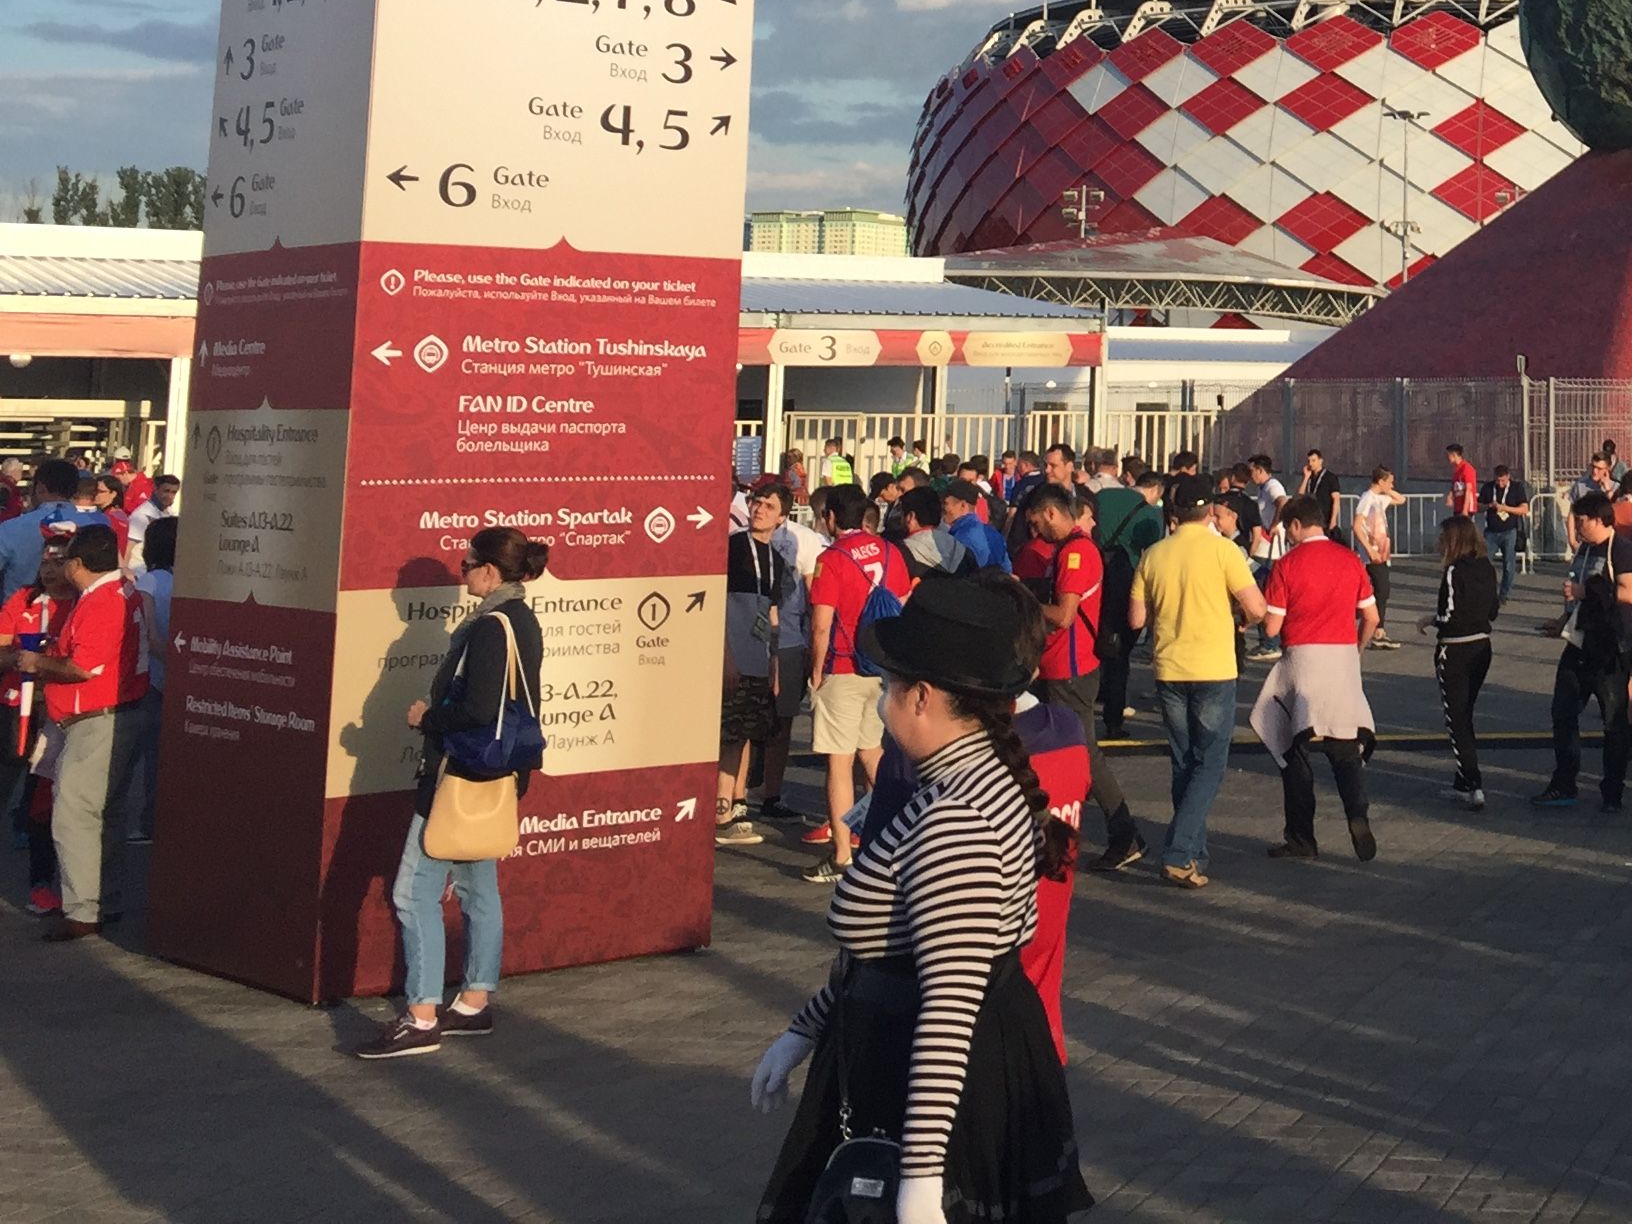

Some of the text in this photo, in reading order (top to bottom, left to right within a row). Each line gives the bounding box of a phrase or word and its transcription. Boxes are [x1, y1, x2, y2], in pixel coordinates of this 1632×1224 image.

[240, 38, 256, 80] 3
[261, 34, 285, 53] Gate
[596, 35, 693, 84] Gate 3
[610, 63, 648, 84] Вход
[280, 97, 304, 117] Gate
[529, 97, 583, 120] Gate
[543, 125, 583, 146] Вход
[229, 176, 246, 218] 6
[251, 173, 275, 192] Gate
[439, 163, 550, 207] 6 Gate
[491, 194, 532, 214] Вход
[414, 269, 696, 293] Please, use the Gate indicated on your ticket
[413, 286, 482, 299] Пожалуйста,
[483, 290, 551, 302] используйте
[580, 292, 632, 304] указанный
[634, 296, 646, 304] на
[648, 294, 681, 306] Вашем
[683, 295, 717, 308] билете
[462, 335, 707, 362] Metro Station Tushinskaya
[779, 341, 811, 355] Gate
[818, 336, 836, 360] 3
[461, 359, 668, 378] Станция метро "Тушинская"
[458, 395, 594, 414] FAN ID Centre
[501, 421, 556, 437] выдачи
[559, 422, 626, 437] паспорта
[457, 438, 549, 454] болельщика
[420, 507, 633, 529] Metro Station Spartak
[559, 530, 632, 549] "Спартак"
[863, 561, 884, 595] 7
[407, 595, 623, 627] Hospit Entrance
[649, 603, 657, 622] 1
[544, 620, 622, 638] ля гостей
[636, 634, 670, 649] Gate
[638, 653, 665, 667] Вход
[542, 703, 616, 728] unge A
[546, 733, 598, 752] Лаунж
[520, 807, 662, 835] Media Entrance
[526, 837, 565, 856] СМИ
[568, 840, 579, 851] и
[582, 827, 661, 850] вещателей
